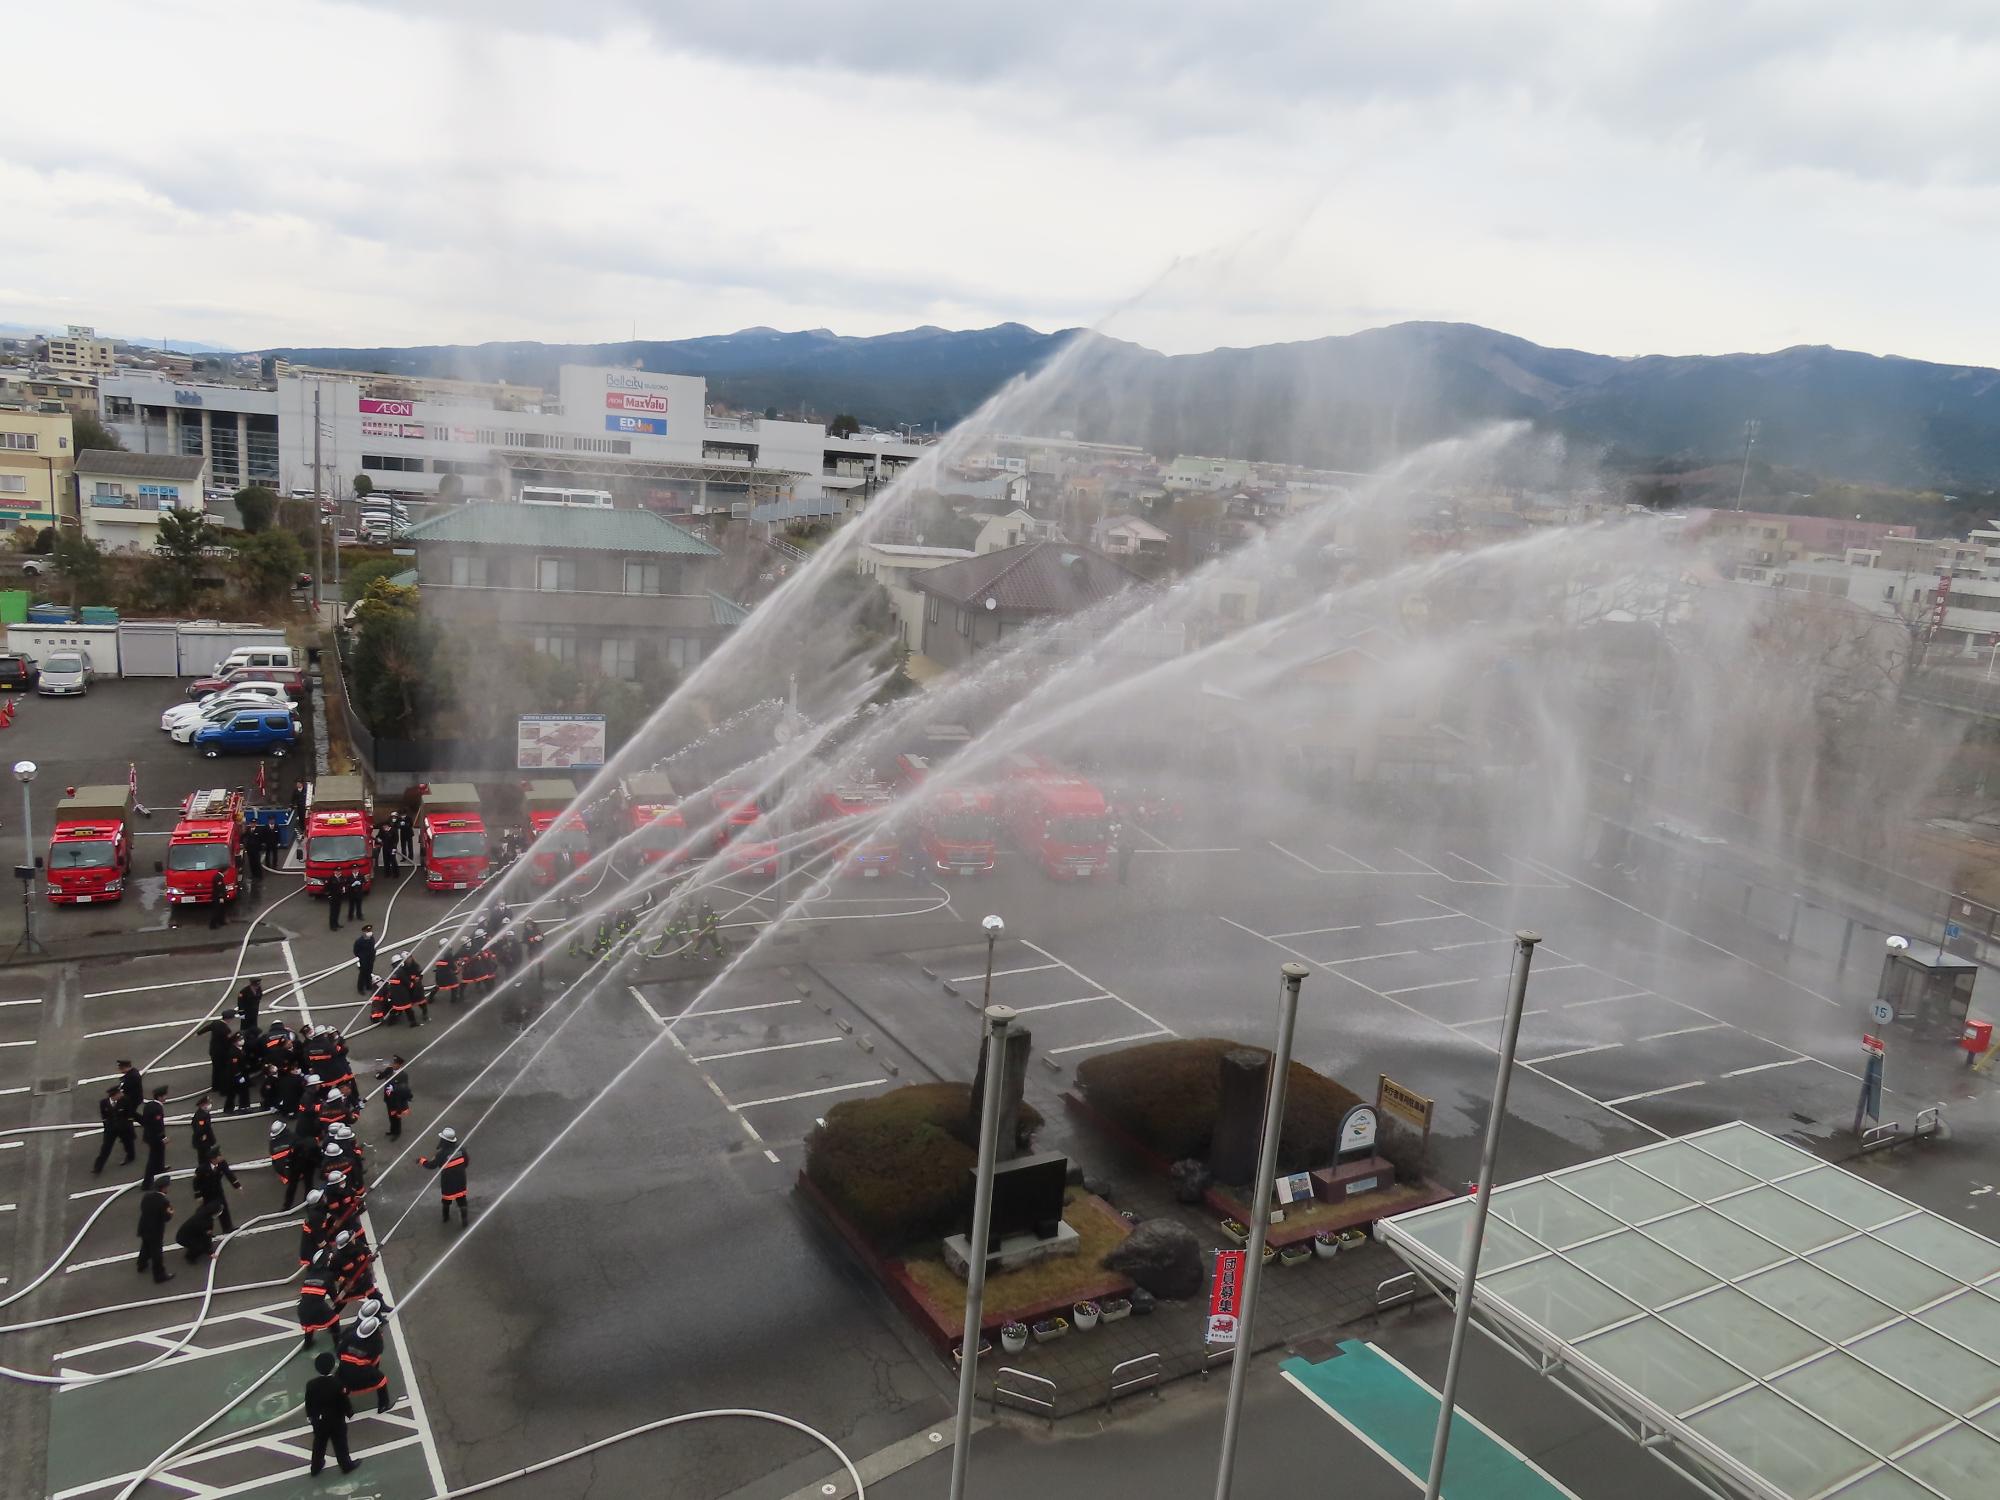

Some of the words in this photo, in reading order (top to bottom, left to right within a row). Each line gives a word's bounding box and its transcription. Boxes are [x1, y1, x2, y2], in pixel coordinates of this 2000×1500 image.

[626, 394, 665, 410] MaxValu
[1874, 1005, 1888, 1019] 15
[1218, 1257, 1237, 1312] 団員募集
